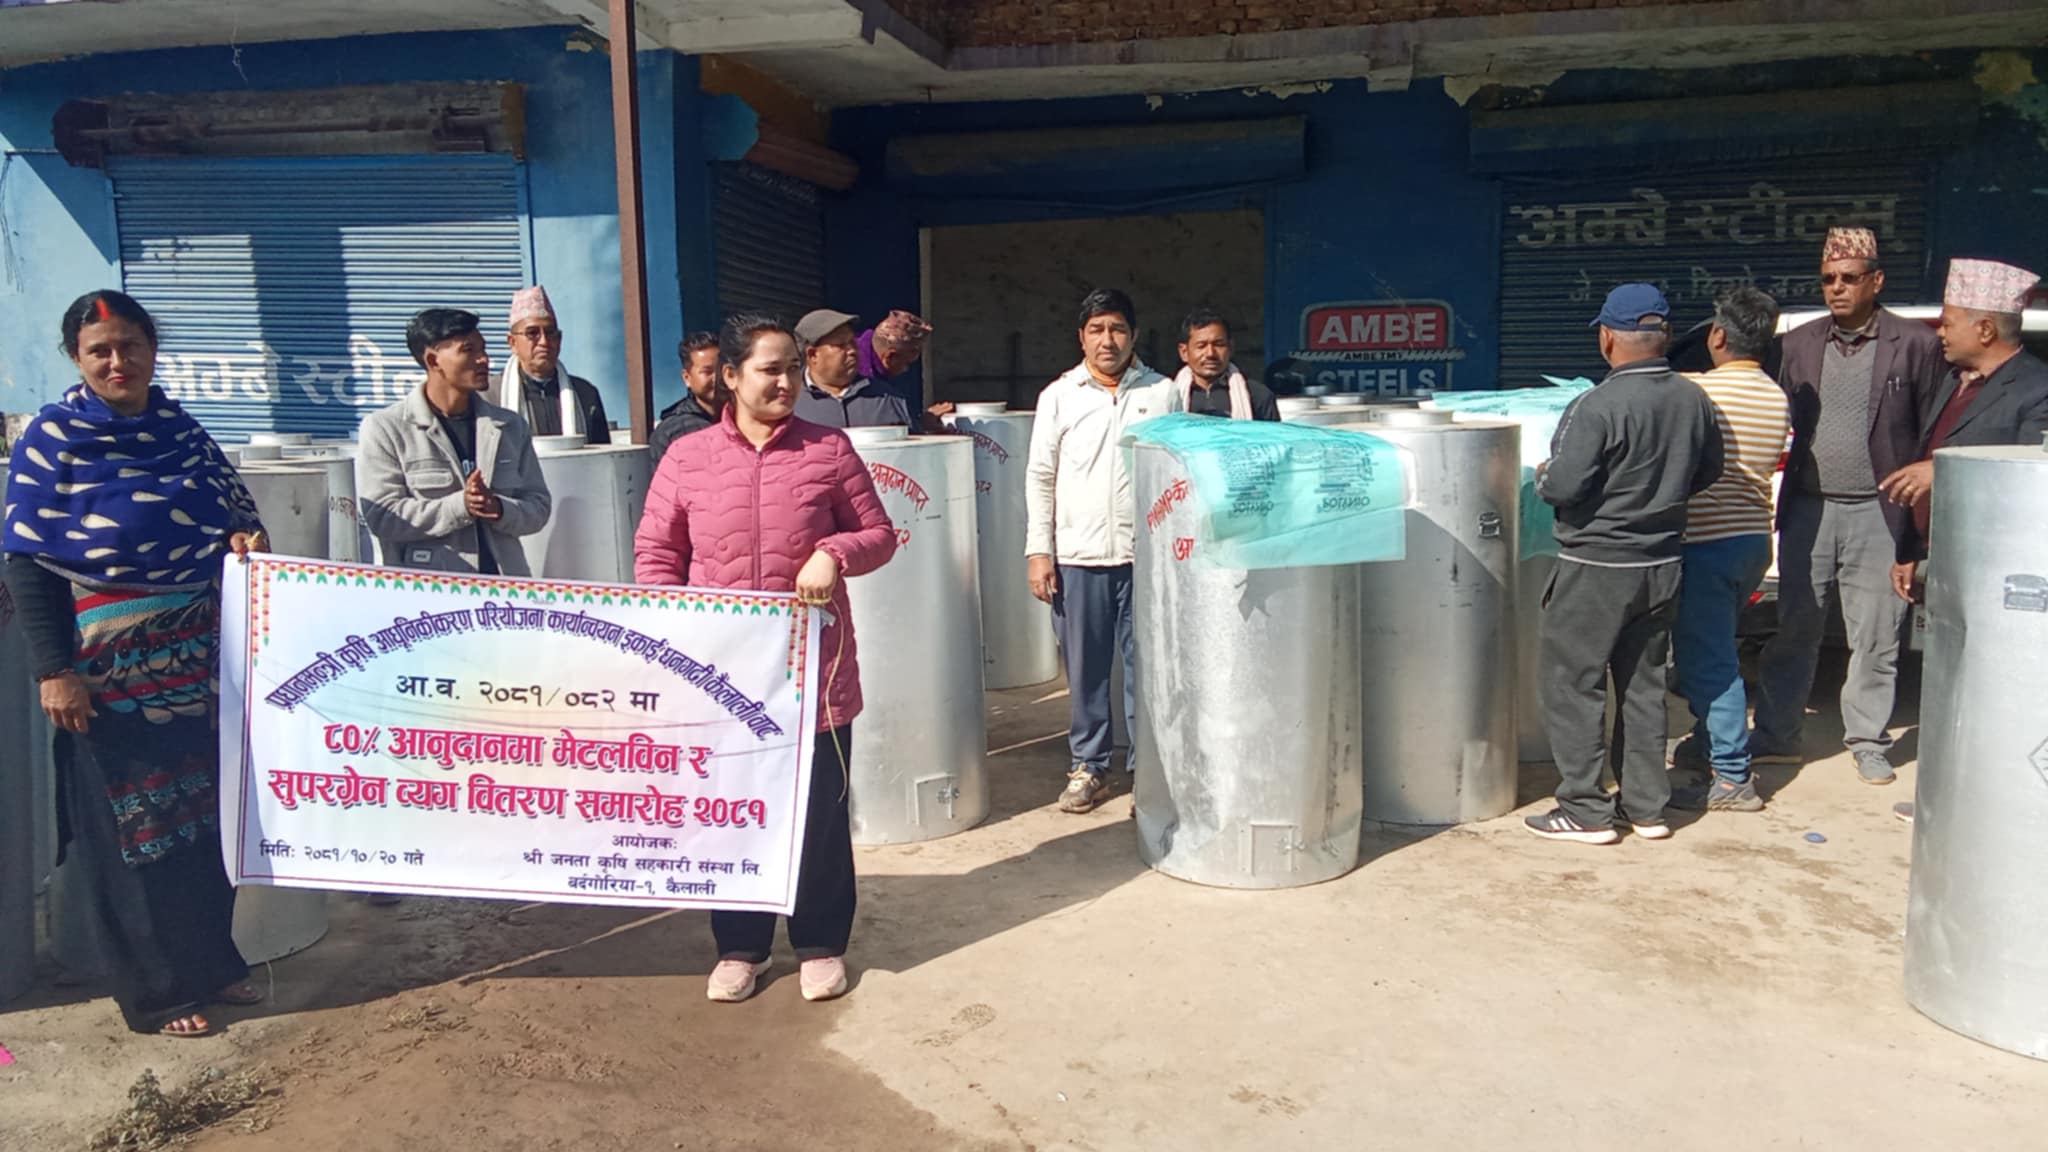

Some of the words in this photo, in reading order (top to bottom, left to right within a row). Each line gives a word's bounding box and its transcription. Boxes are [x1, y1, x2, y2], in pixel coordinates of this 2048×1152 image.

[1318, 313, 1436, 344] AMBE
[1345, 351, 1376, 361] AMBE
[337, 635, 375, 672] कृषि
[476, 601, 545, 631] परियोजना
[623, 628, 663, 664] इकाई
[396, 674, 461, 701] आ.व.
[479, 681, 616, 712] २०८१/०८२
[629, 691, 660, 713] मा
[387, 727, 546, 770] आनुदानमा
[688, 744, 715, 779] र
[467, 773, 567, 819] वितरण
[574, 785, 688, 829] समारोह
[693, 796, 768, 828] २०८१
[304, 845, 397, 866] २०८१/१०/२०
[403, 848, 425, 866] गते
[523, 850, 543, 866] श्री
[550, 852, 590, 868] जनता
[597, 852, 628, 875] कृषि
[634, 856, 692, 875] सहकारी
[697, 859, 736, 877] संस्था
[741, 858, 764, 878] लि.
[665, 876, 718, 897] कैलाली
